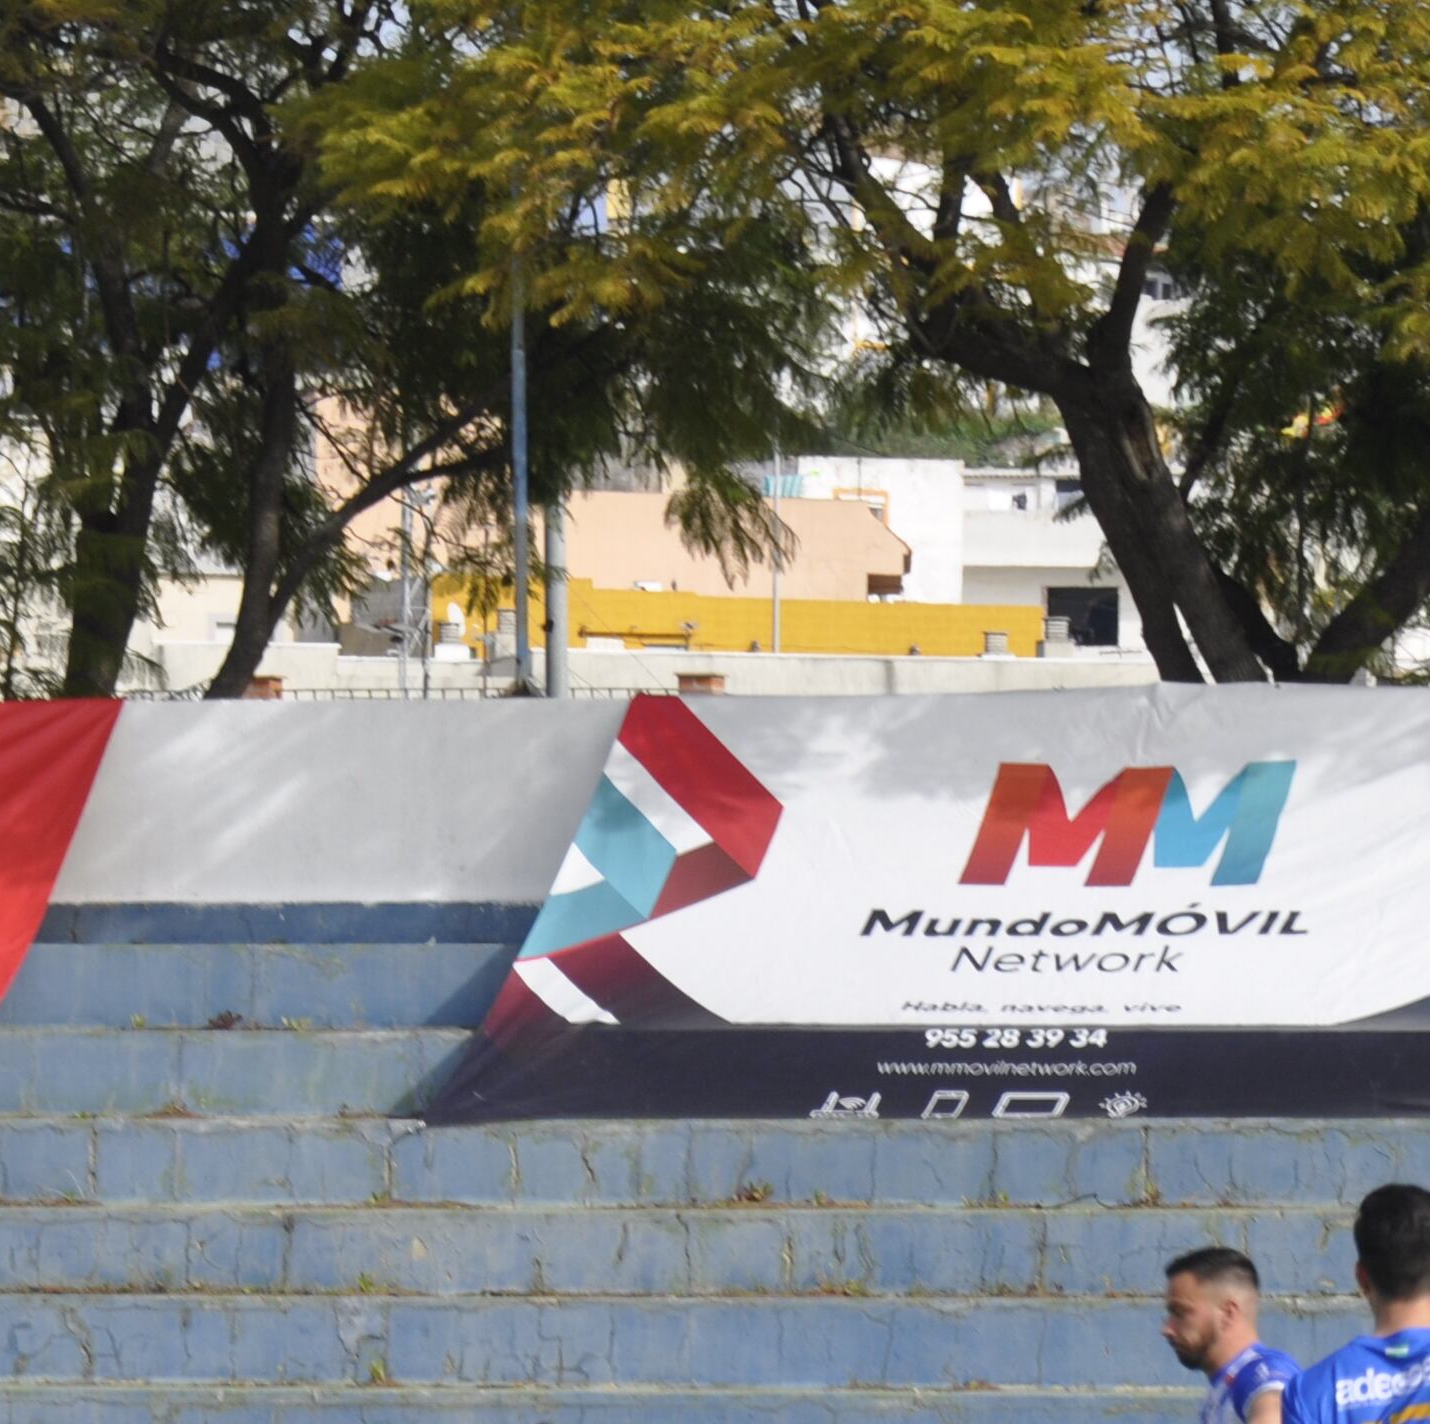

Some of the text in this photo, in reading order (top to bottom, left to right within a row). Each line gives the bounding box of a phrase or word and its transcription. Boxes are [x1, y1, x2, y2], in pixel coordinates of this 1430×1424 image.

[958, 760, 1297, 887] MM
[860, 902, 1310, 938] MundoMÓVIL
[950, 946, 1185, 974] Network
[925, 1028, 1109, 1049] 955 28 39 34
